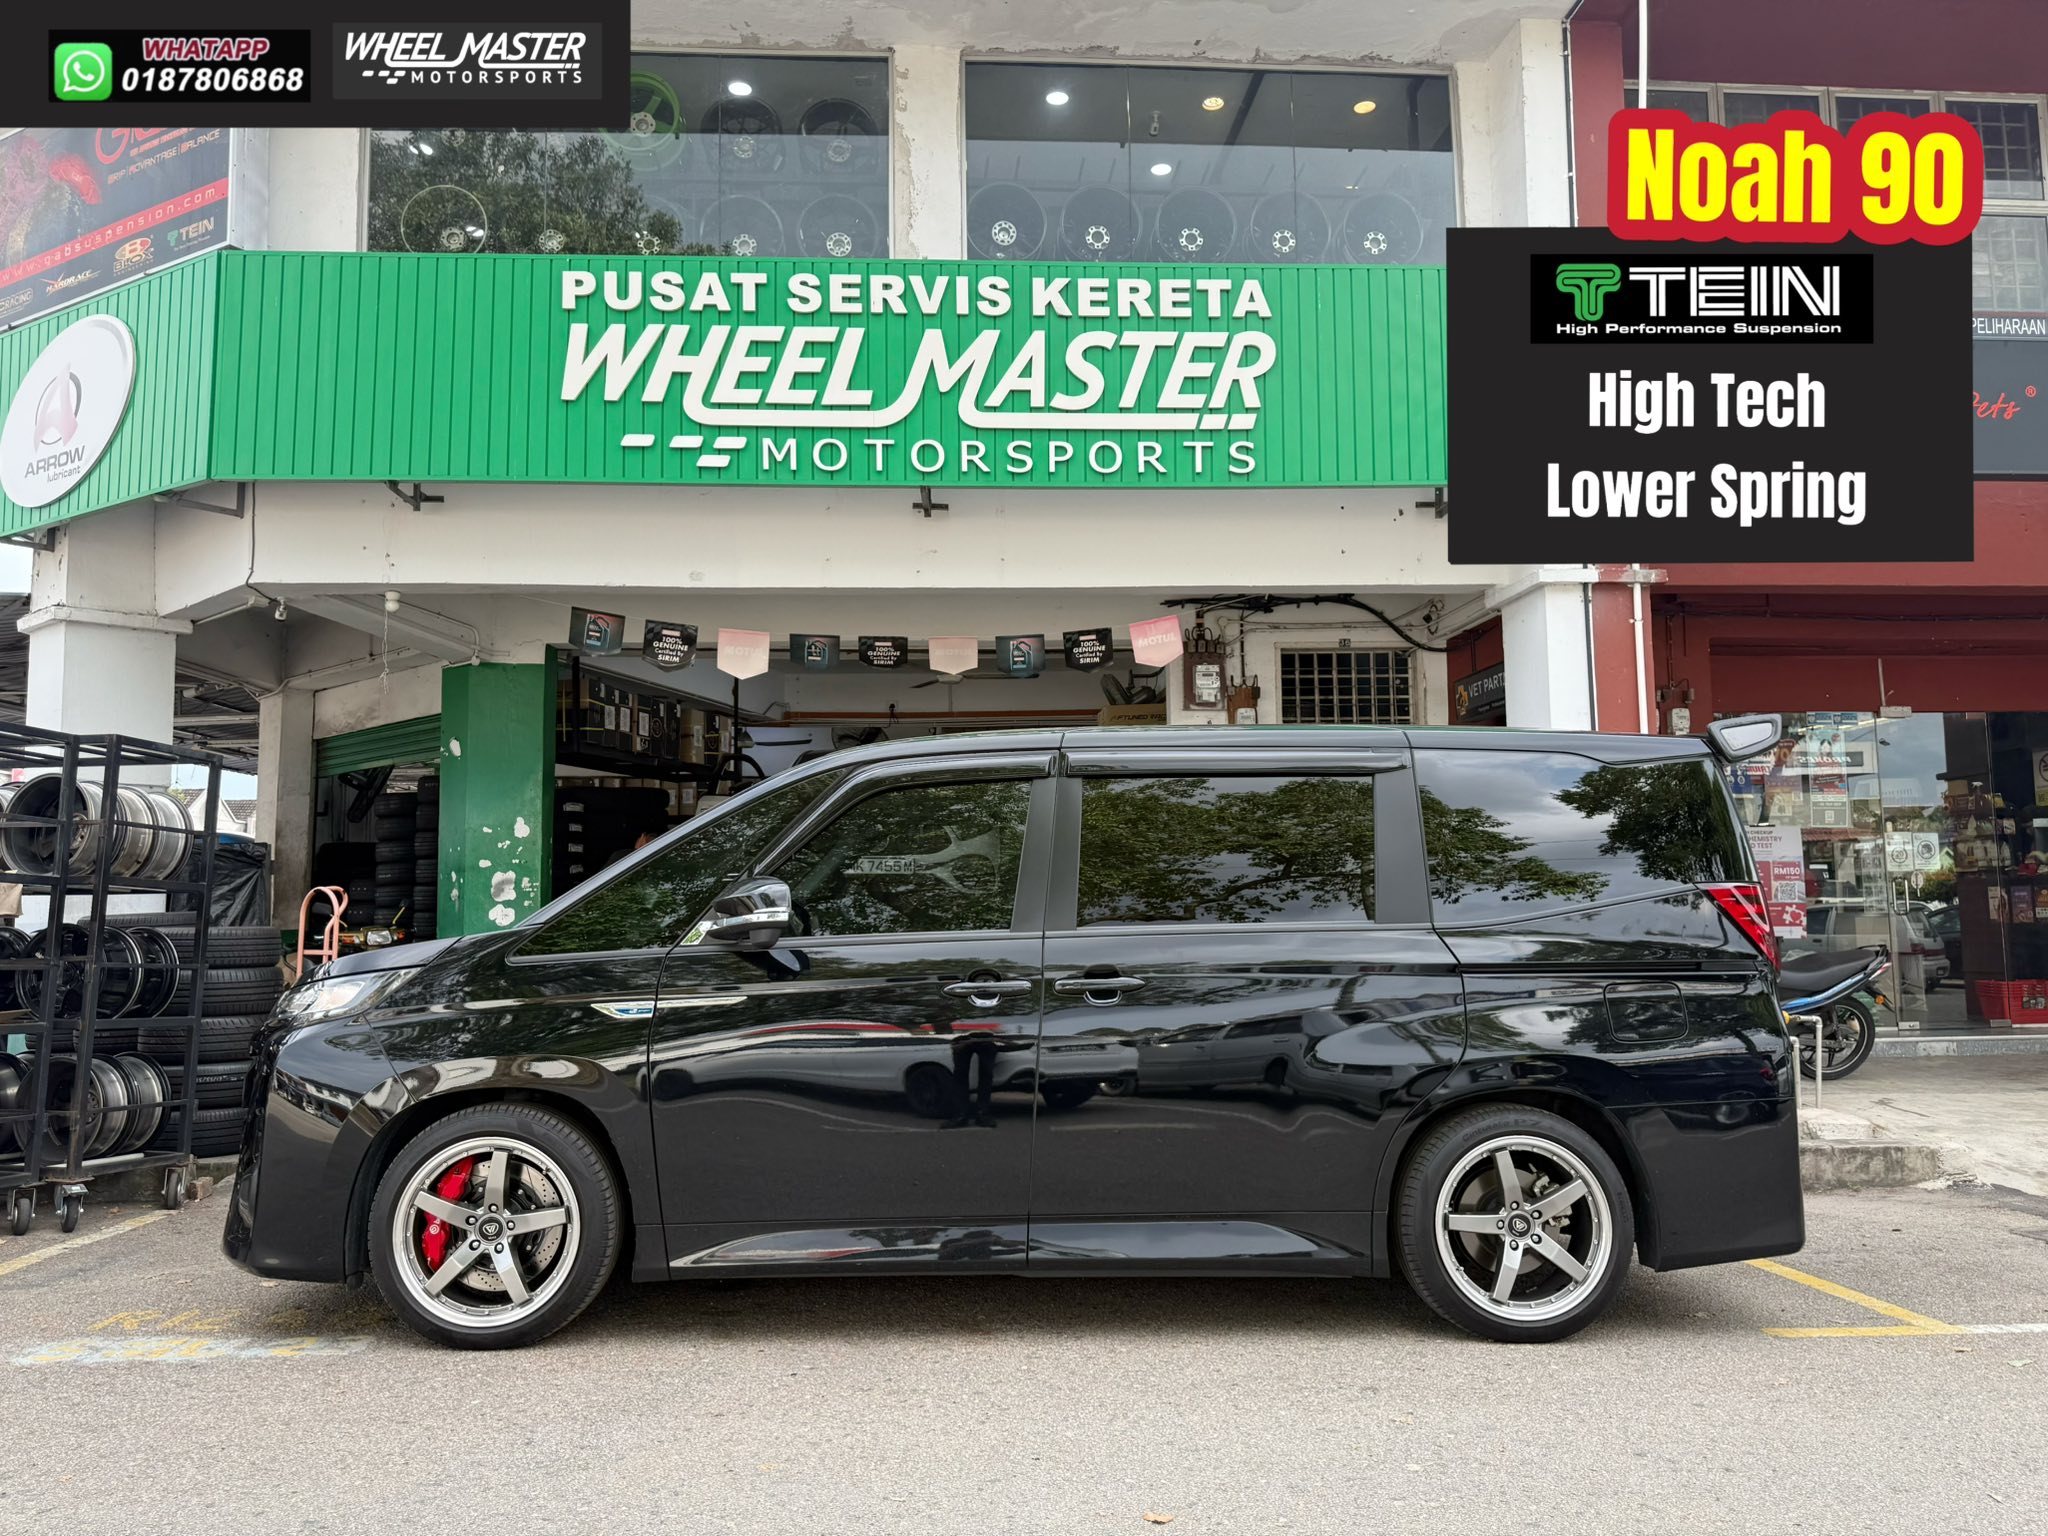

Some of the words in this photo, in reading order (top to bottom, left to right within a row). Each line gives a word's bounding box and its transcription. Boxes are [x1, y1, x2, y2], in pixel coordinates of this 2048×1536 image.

[180, 217, 214, 241] TEIN
[562, 269, 768, 313] PUSAT
[786, 272, 1013, 317] SERVIS
[1031, 276, 1272, 320] KERETA
[561, 322, 874, 428] WHEEL
[902, 329, 1277, 430] MASTER
[24, 445, 85, 479] ARROW
[761, 437, 1256, 475] MOTORSPORTS
[47, 465, 81, 483] lubricant
[653, 641, 688, 652] GENUINE
[662, 636, 682, 645] 100%
[1073, 645, 1106, 653] GENUINE
[1138, 633, 1177, 648] MOTUL
[657, 654, 680, 663] SIRIM
